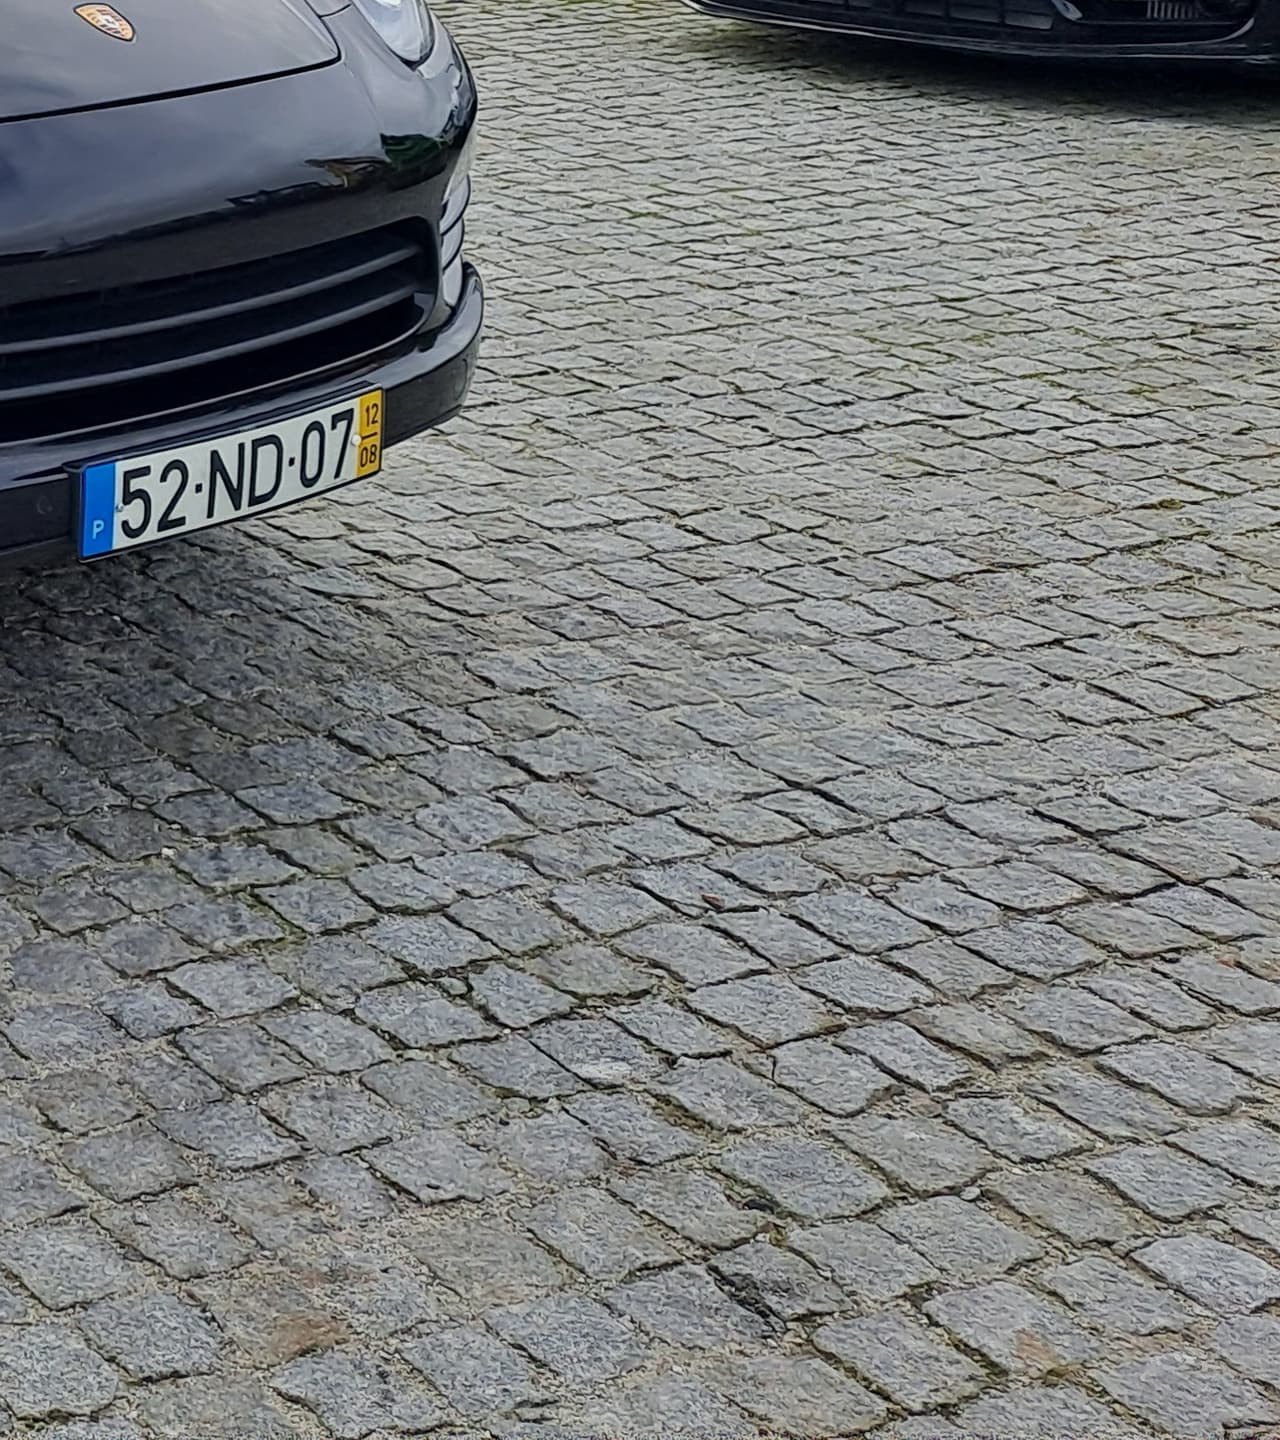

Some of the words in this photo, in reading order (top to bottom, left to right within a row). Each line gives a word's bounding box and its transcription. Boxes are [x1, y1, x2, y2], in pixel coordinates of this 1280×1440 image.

[364, 402, 379, 427] 12
[359, 443, 377, 468] 08
[92, 520, 105, 540] P
